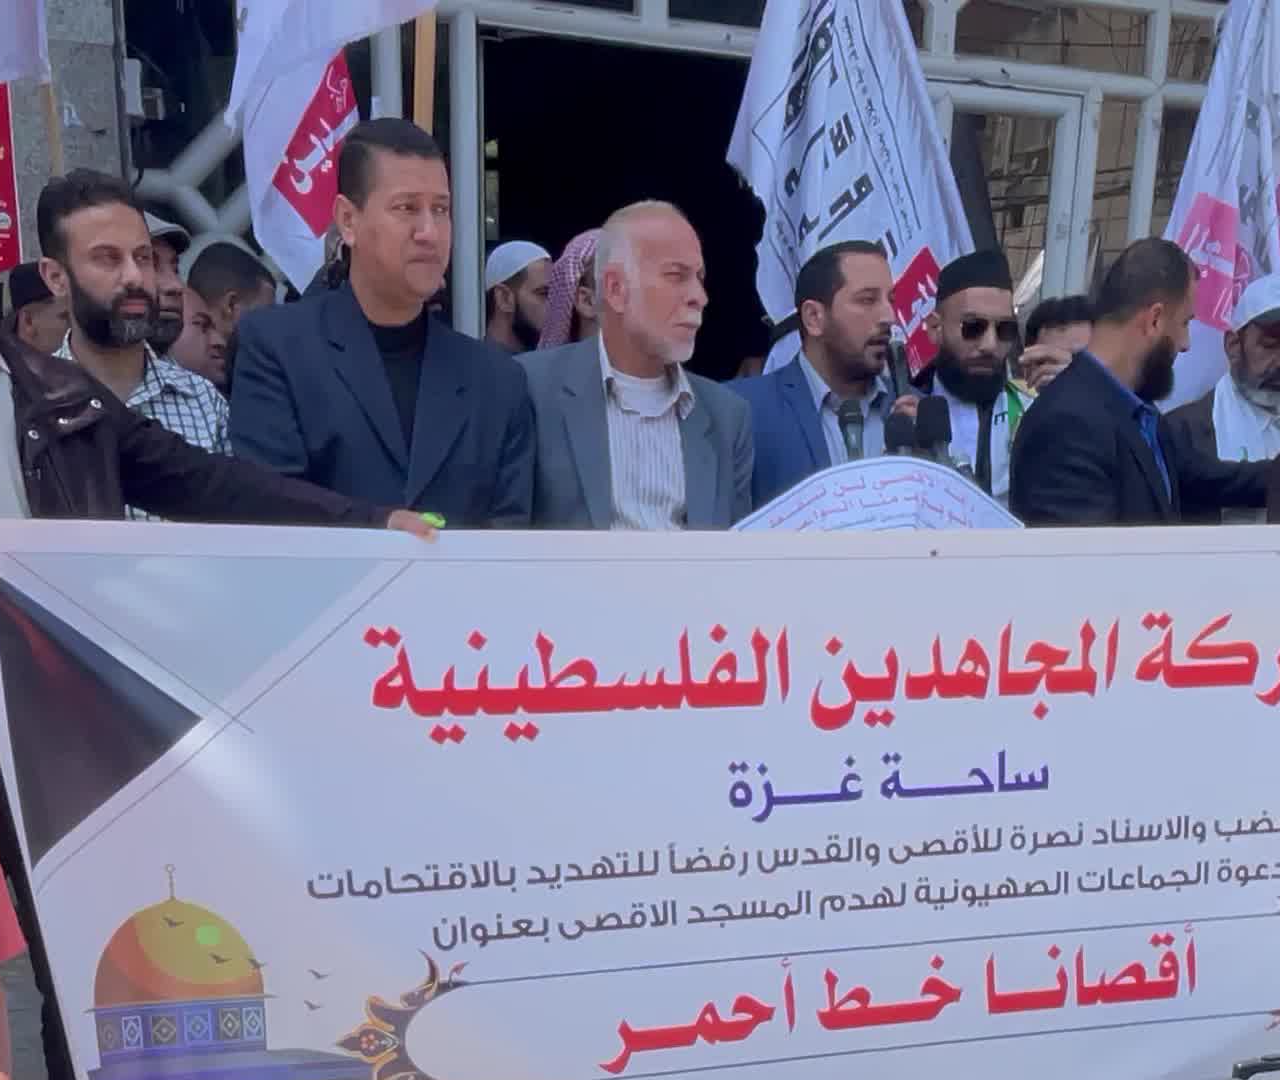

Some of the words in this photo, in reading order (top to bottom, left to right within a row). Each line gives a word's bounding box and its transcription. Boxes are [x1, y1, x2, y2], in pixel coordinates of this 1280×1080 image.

[363, 623, 790, 745] الفلسطينية
[810, 617, 1119, 731] المجاهدين
[728, 755, 864, 822] غزة
[880, 748, 1050, 800] ساحة
[888, 824, 1003, 864] للأقصى
[1010, 822, 1084, 855] نصرة
[1092, 814, 1207, 848] والاسناد
[526, 849, 660, 890] للتهديد
[757, 834, 880, 875] والقدس
[306, 860, 516, 899] بالاقتحامات
[914, 869, 1070, 911] الصهيونية
[1077, 861, 1210, 893] الجماعات
[558, 902, 677, 940] الاقصى
[687, 889, 812, 928] المسجد
[819, 882, 907, 920] لهدم
[432, 913, 550, 951] بعنوان
[985, 922, 1198, 1015] أقصانا
[816, 954, 963, 1031] خط
[598, 956, 797, 1075] أحمر
